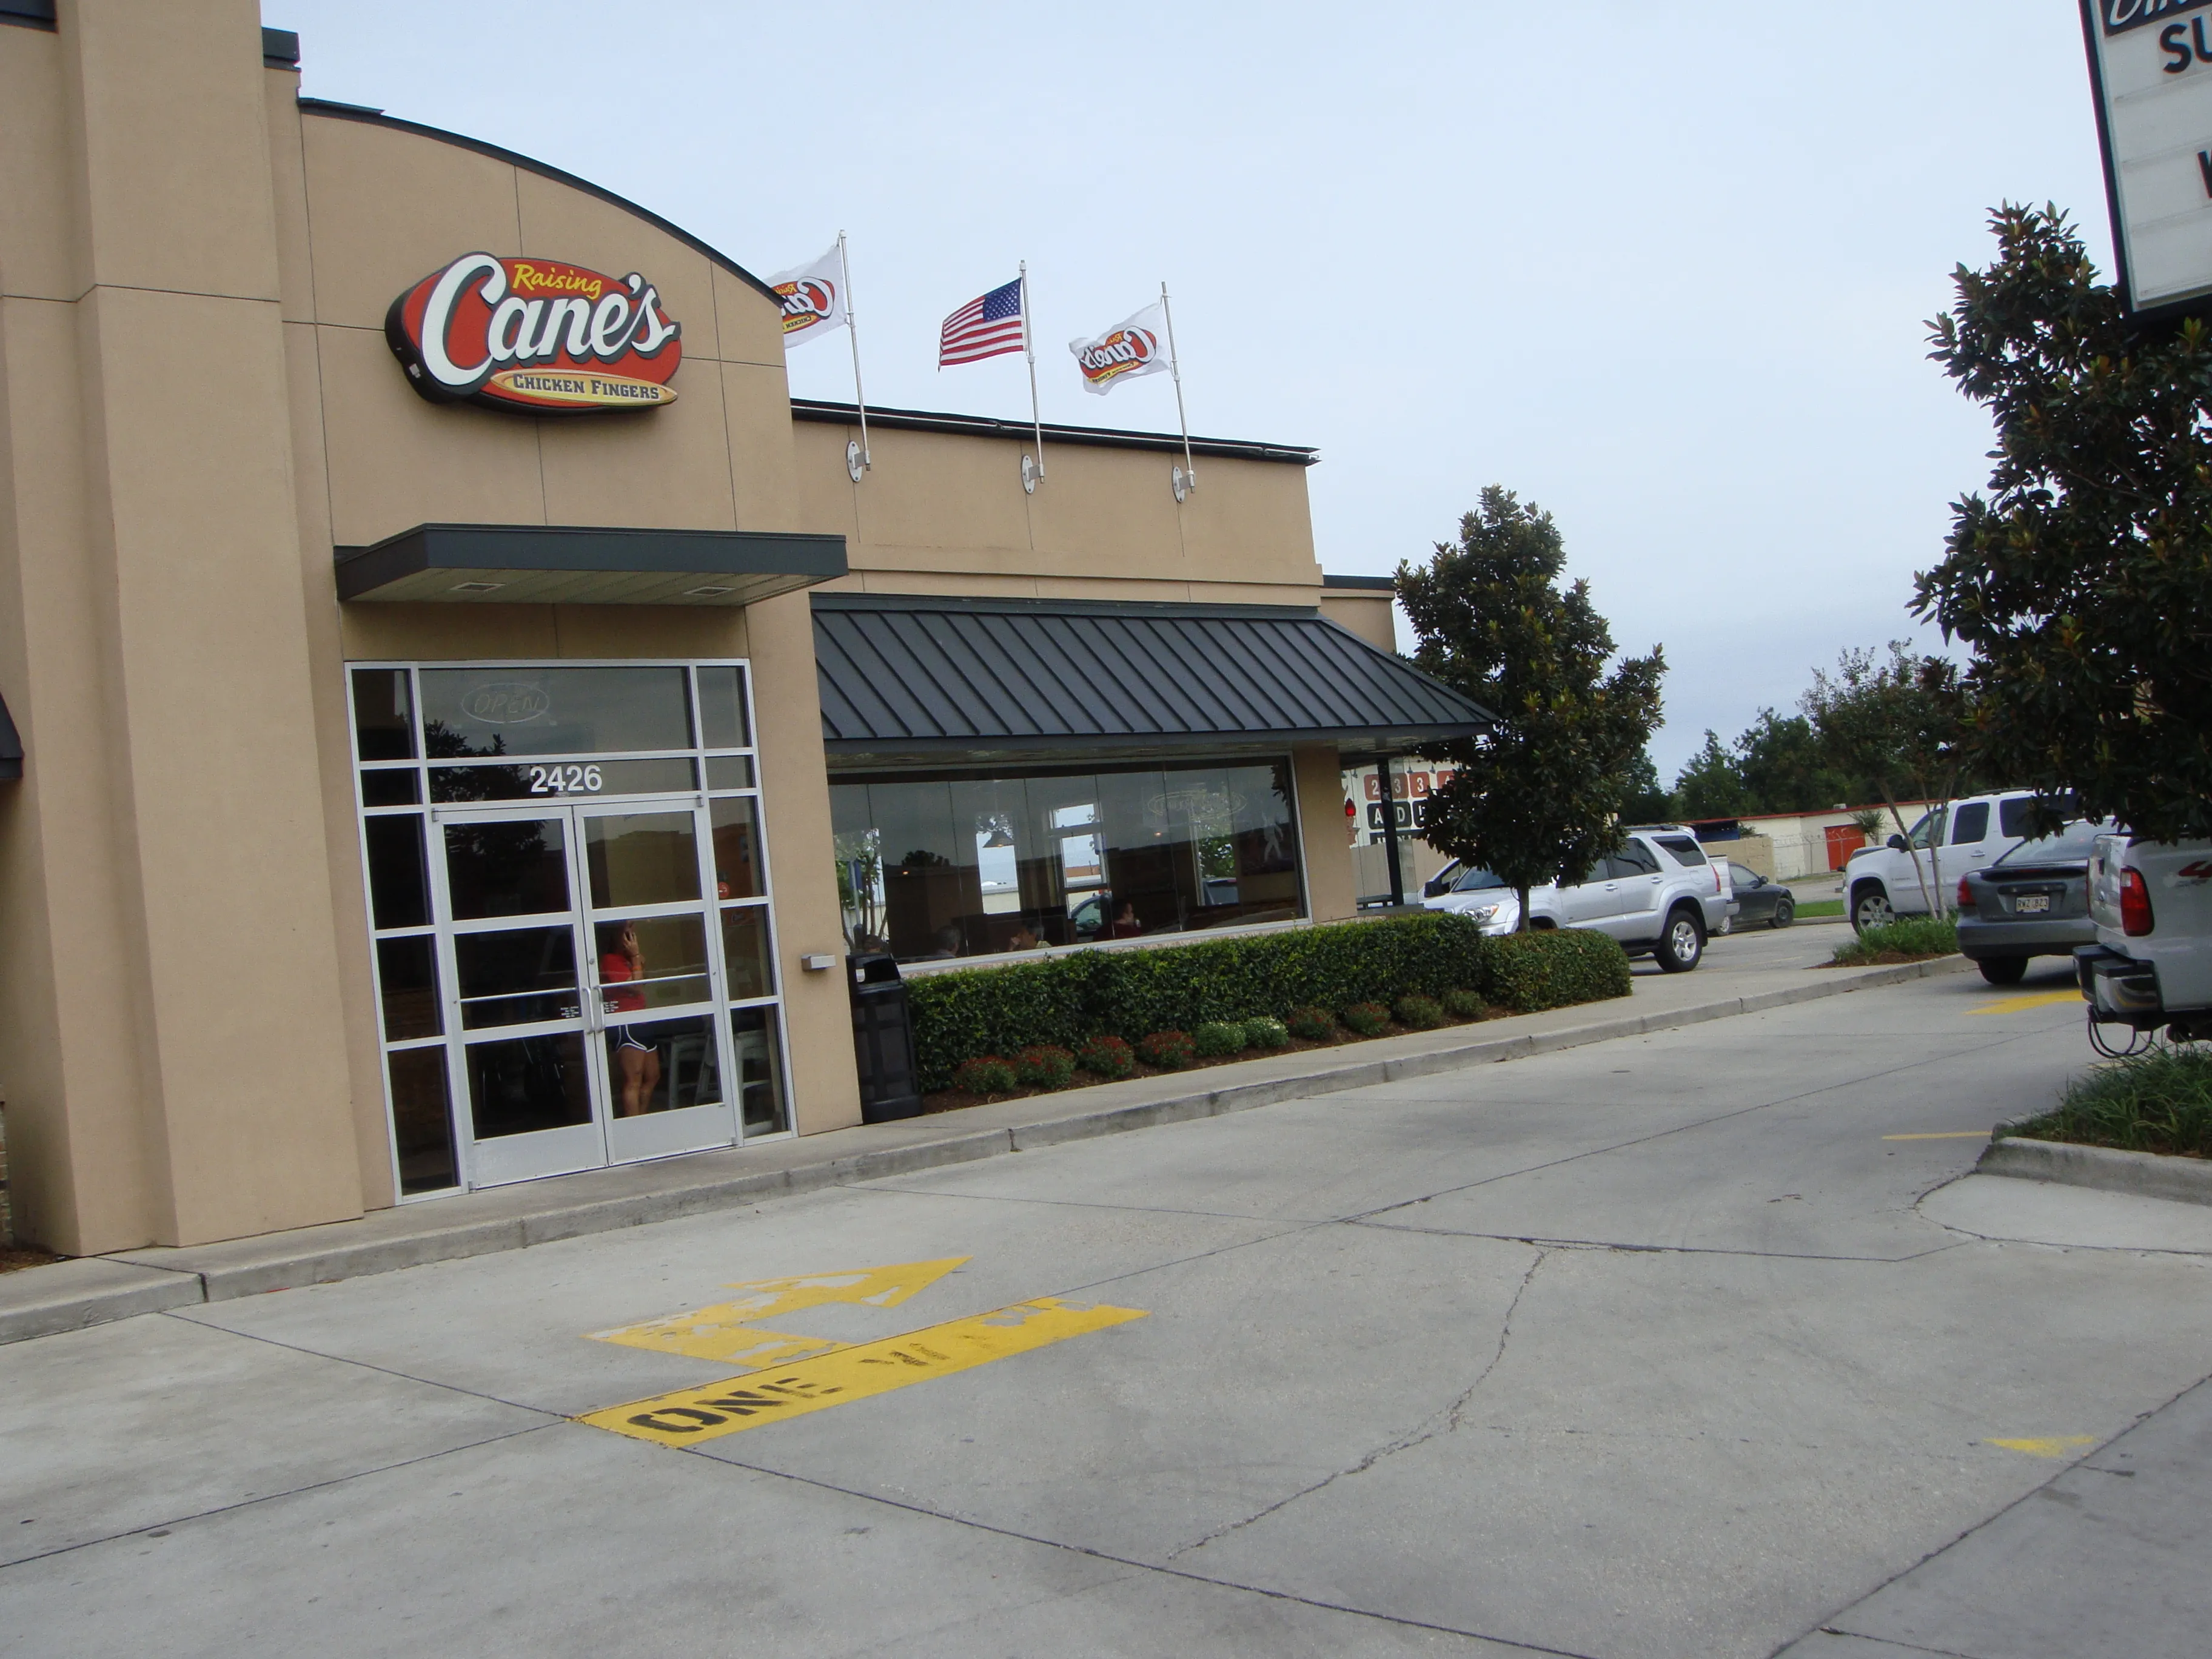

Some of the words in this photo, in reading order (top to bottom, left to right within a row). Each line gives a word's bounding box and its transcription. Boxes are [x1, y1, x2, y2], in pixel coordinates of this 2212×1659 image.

[513, 264, 602, 299] Raising
[421, 255, 675, 385] Cane's
[513, 374, 585, 394] CHICKEN
[591, 380, 659, 400] FINGERS
[475, 694, 539, 713] OPEN
[530, 765, 602, 793] 2426
